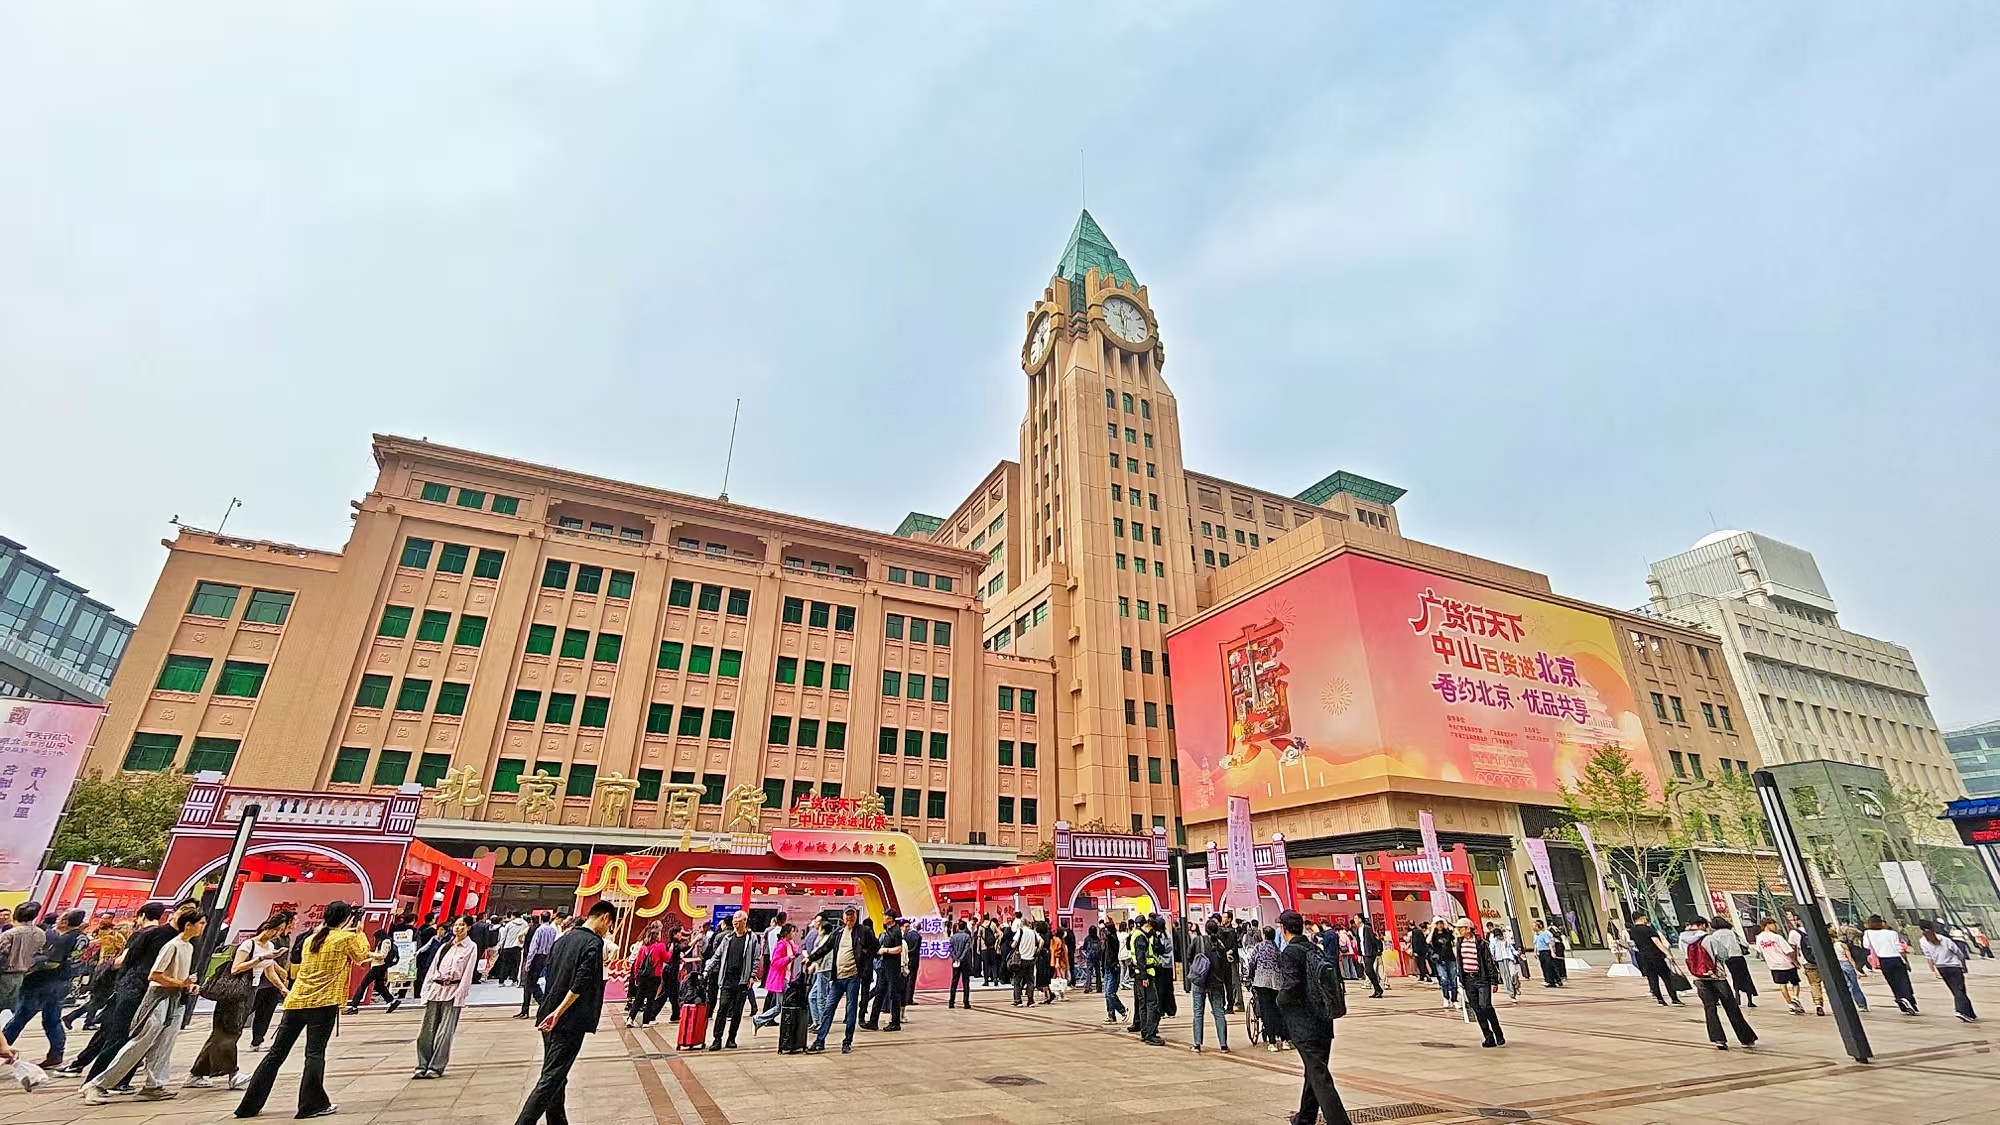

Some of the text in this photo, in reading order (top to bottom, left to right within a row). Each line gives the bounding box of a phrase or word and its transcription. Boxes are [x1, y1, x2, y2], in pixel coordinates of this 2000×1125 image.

[1409, 587, 1526, 643] 广货行天下
[1431, 631, 1581, 689] 中山百货进北京
[1431, 673, 1592, 725] 香约北京·优品共享
[798, 813, 888, 831] 中山百货进北京
